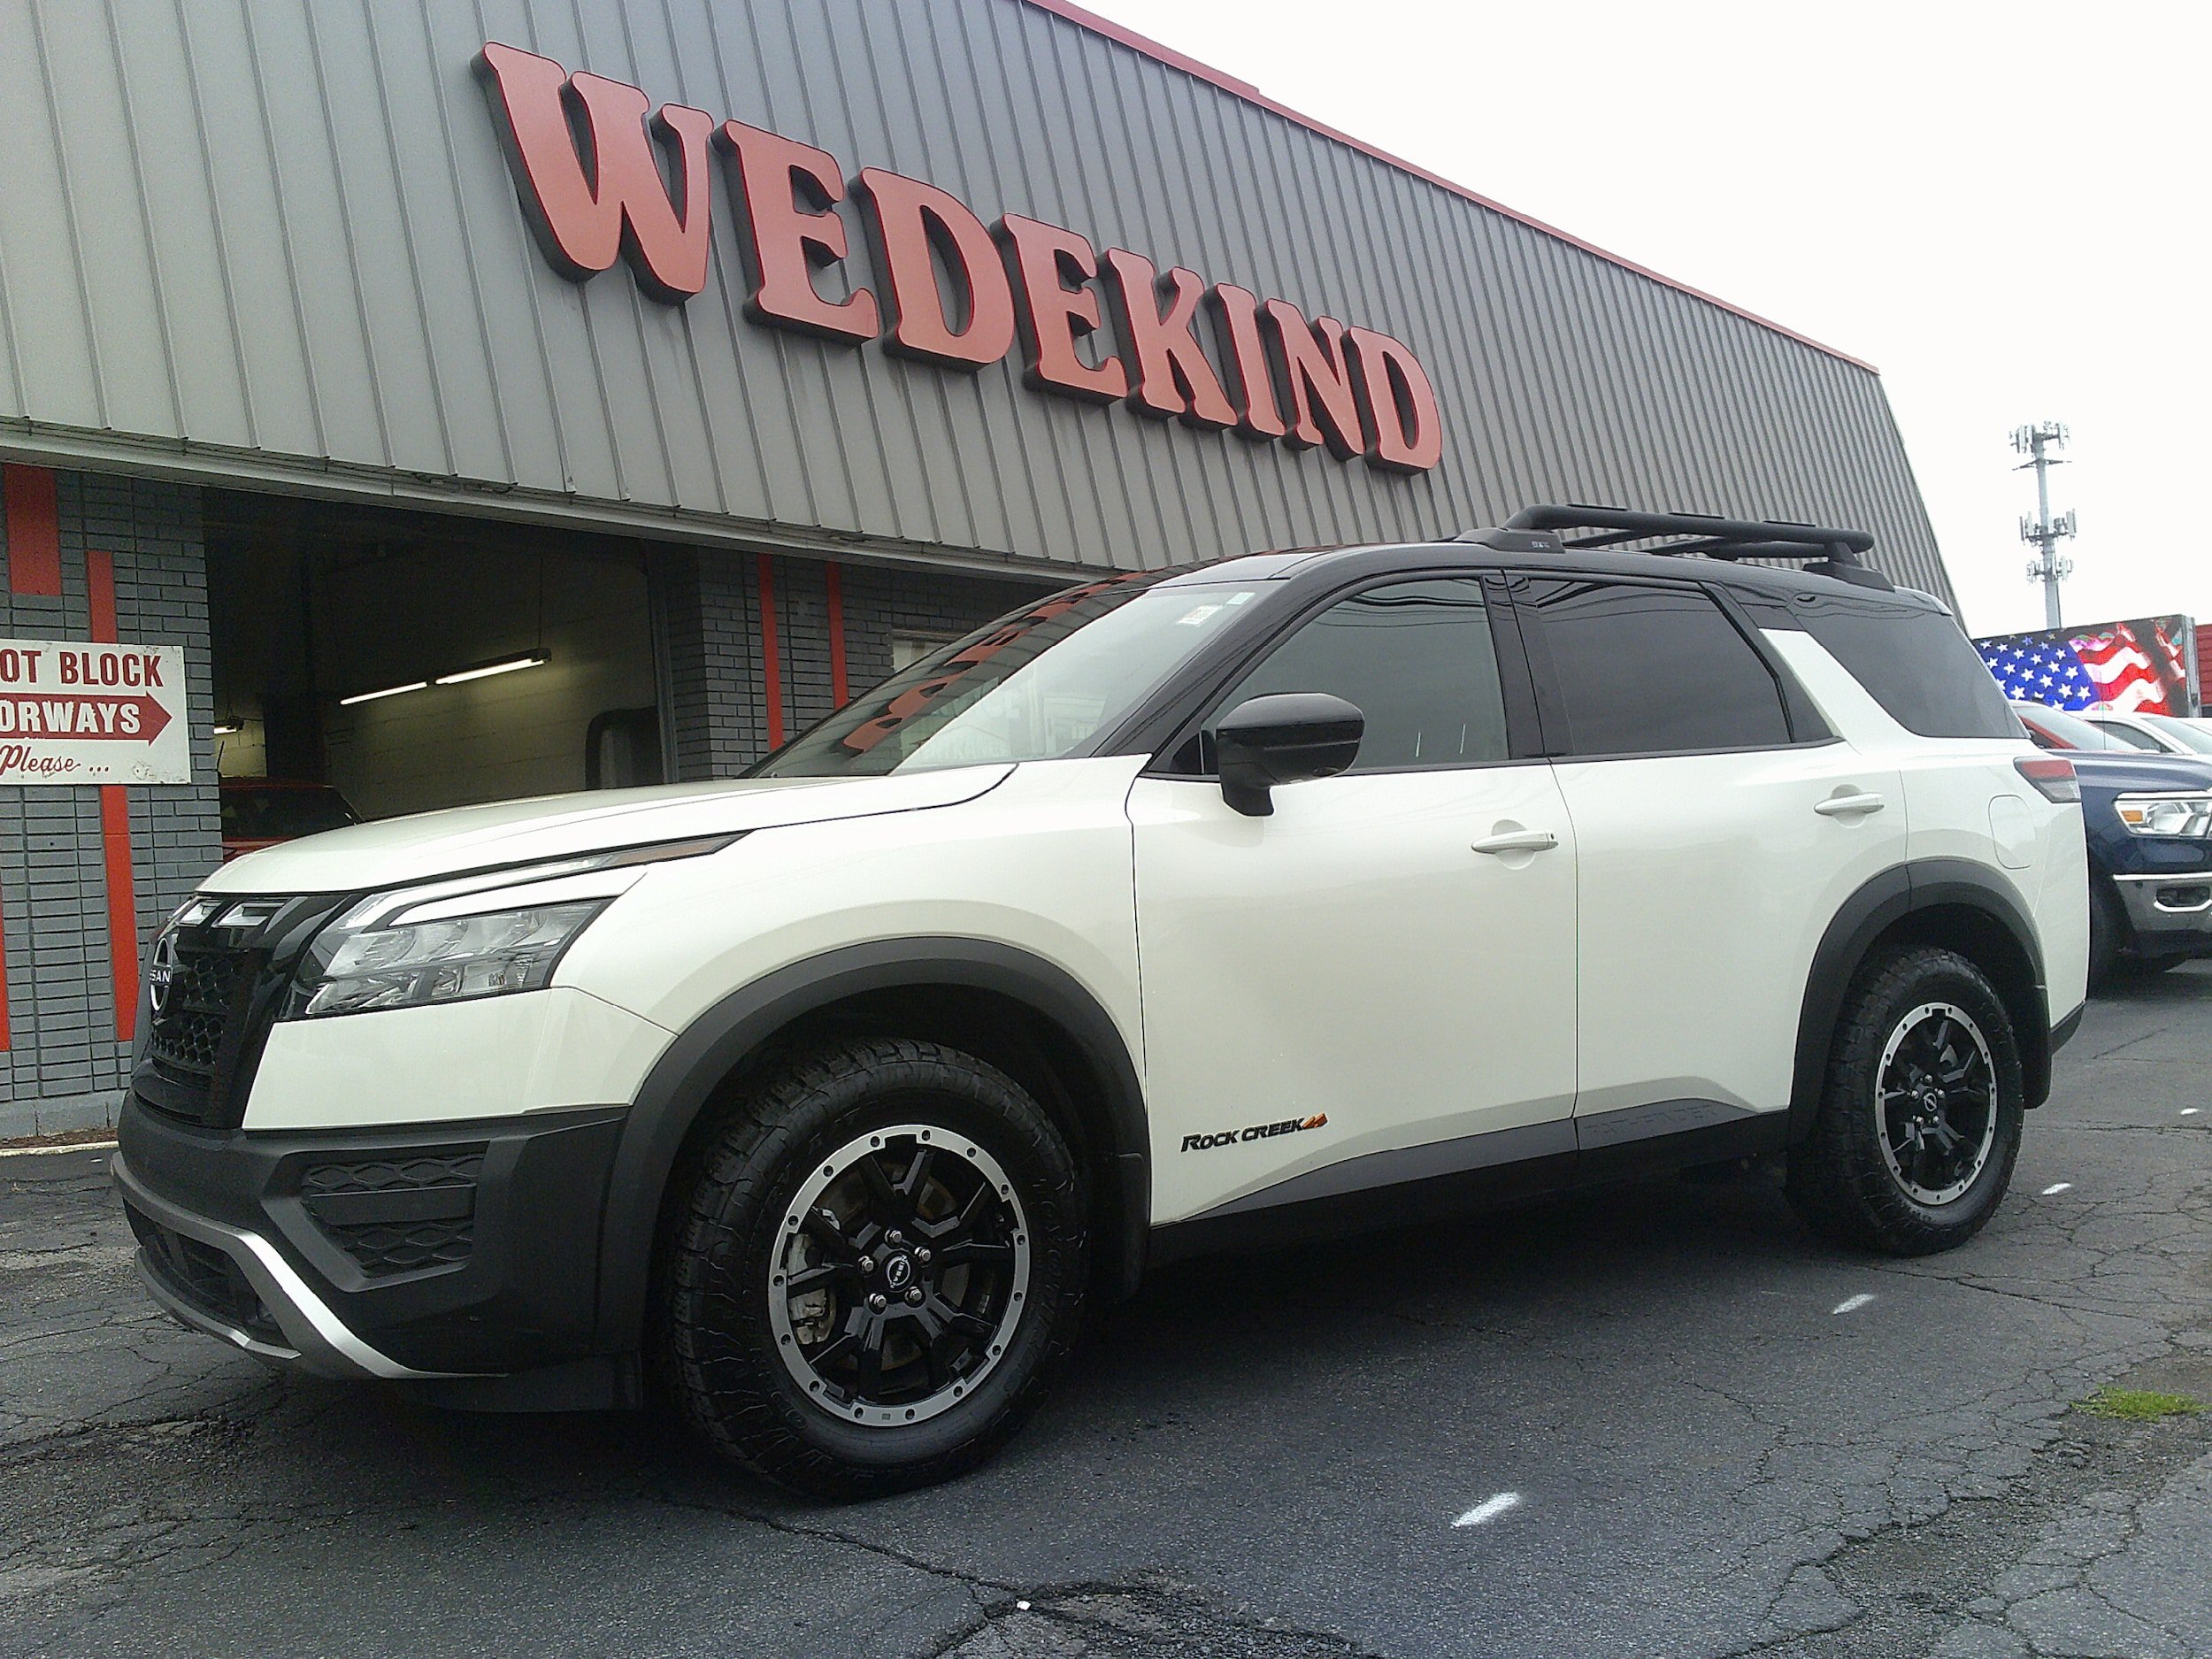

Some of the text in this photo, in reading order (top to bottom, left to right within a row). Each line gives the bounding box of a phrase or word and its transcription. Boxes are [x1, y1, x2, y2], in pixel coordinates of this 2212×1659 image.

[476, 42, 1444, 472] WEDEKIND
[59, 651, 165, 687] BLOCK
[0, 744, 81, 776] Please
[149, 968, 171, 983] SAN
[1180, 1117, 1306, 1153] ROCK CREEK
